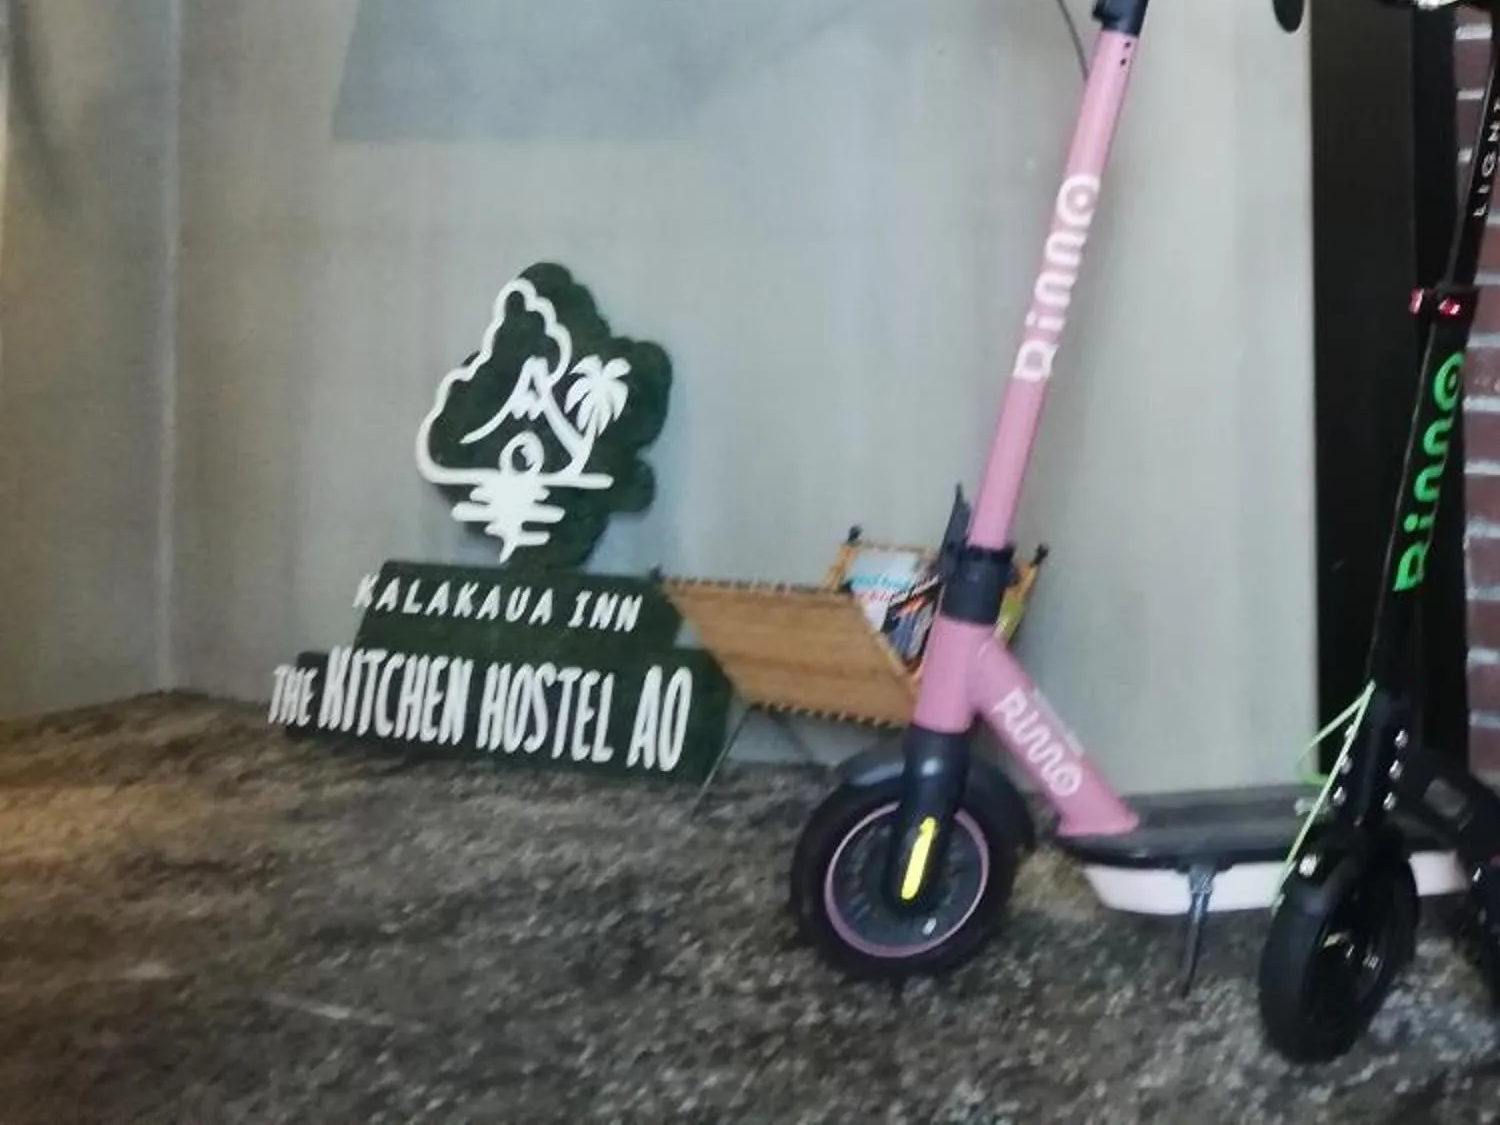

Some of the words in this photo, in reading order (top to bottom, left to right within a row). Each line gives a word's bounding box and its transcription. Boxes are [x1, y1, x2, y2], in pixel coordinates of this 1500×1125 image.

[351, 572, 555, 626] KALAKAUA
[566, 589, 643, 633] INN
[266, 663, 319, 726] THE
[317, 645, 474, 747] KITCHEN
[475, 661, 615, 764] HOSTEL
[625, 665, 694, 773] AO
